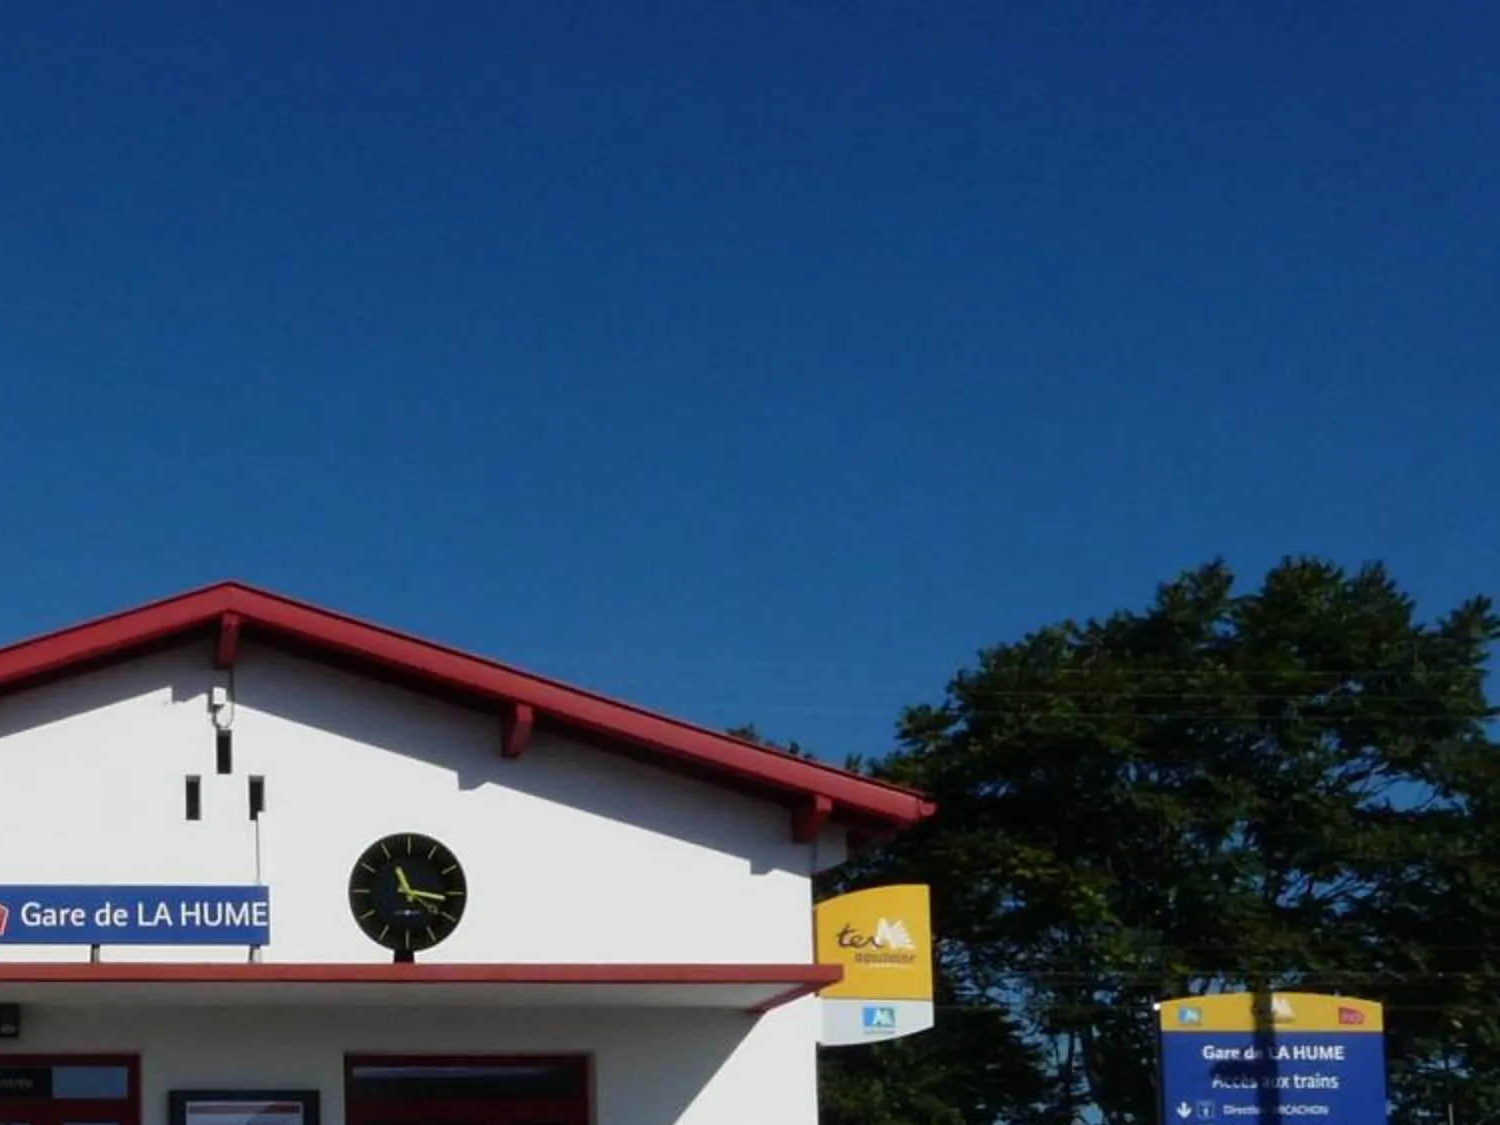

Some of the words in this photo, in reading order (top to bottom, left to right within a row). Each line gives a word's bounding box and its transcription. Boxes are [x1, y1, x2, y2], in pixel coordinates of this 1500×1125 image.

[21, 901, 86, 926] Gare
[94, 901, 128, 926] de
[138, 902, 173, 926] LA
[181, 902, 268, 926] HUME
[1202, 1045, 1241, 1060] Gare
[1293, 1045, 1345, 1060] HUME
[1293, 1073, 1339, 1089] trains
